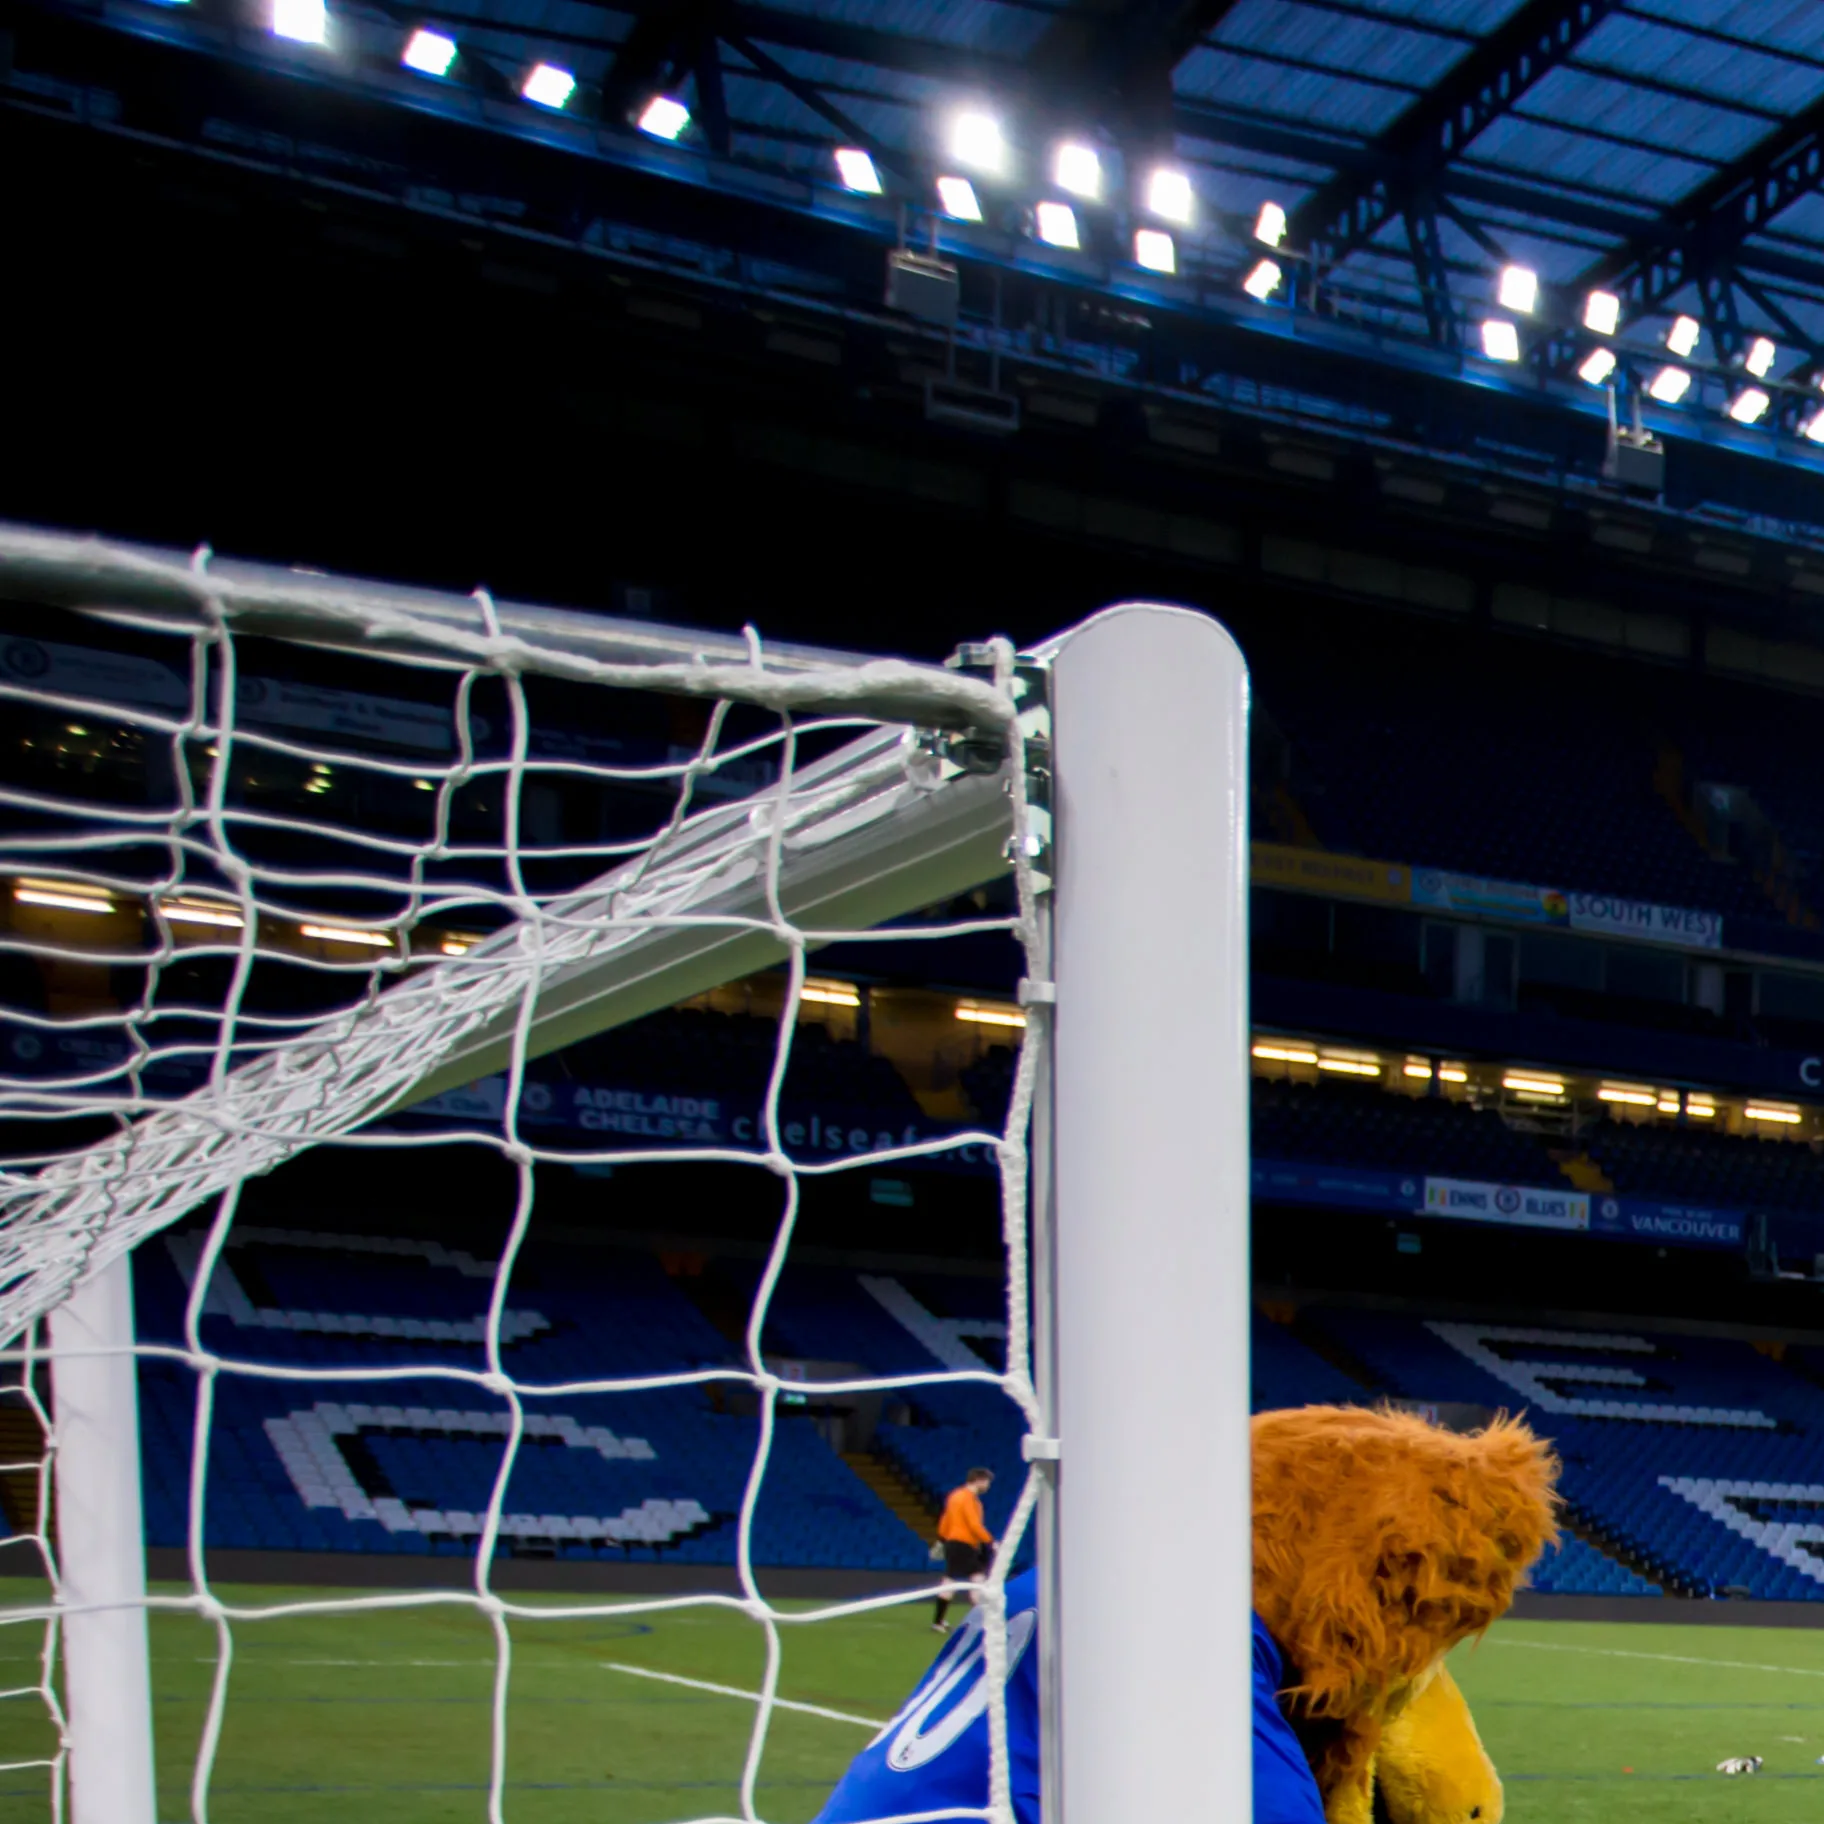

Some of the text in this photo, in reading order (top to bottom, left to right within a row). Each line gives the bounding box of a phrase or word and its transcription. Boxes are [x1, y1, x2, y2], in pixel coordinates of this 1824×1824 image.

[1575, 894, 1721, 936] SOUTH WEST
[572, 1085, 721, 1120] ADELAIDE
[577, 1109, 722, 1140] CHELSEA
[1630, 1213, 1741, 1241] VANCOUVER
